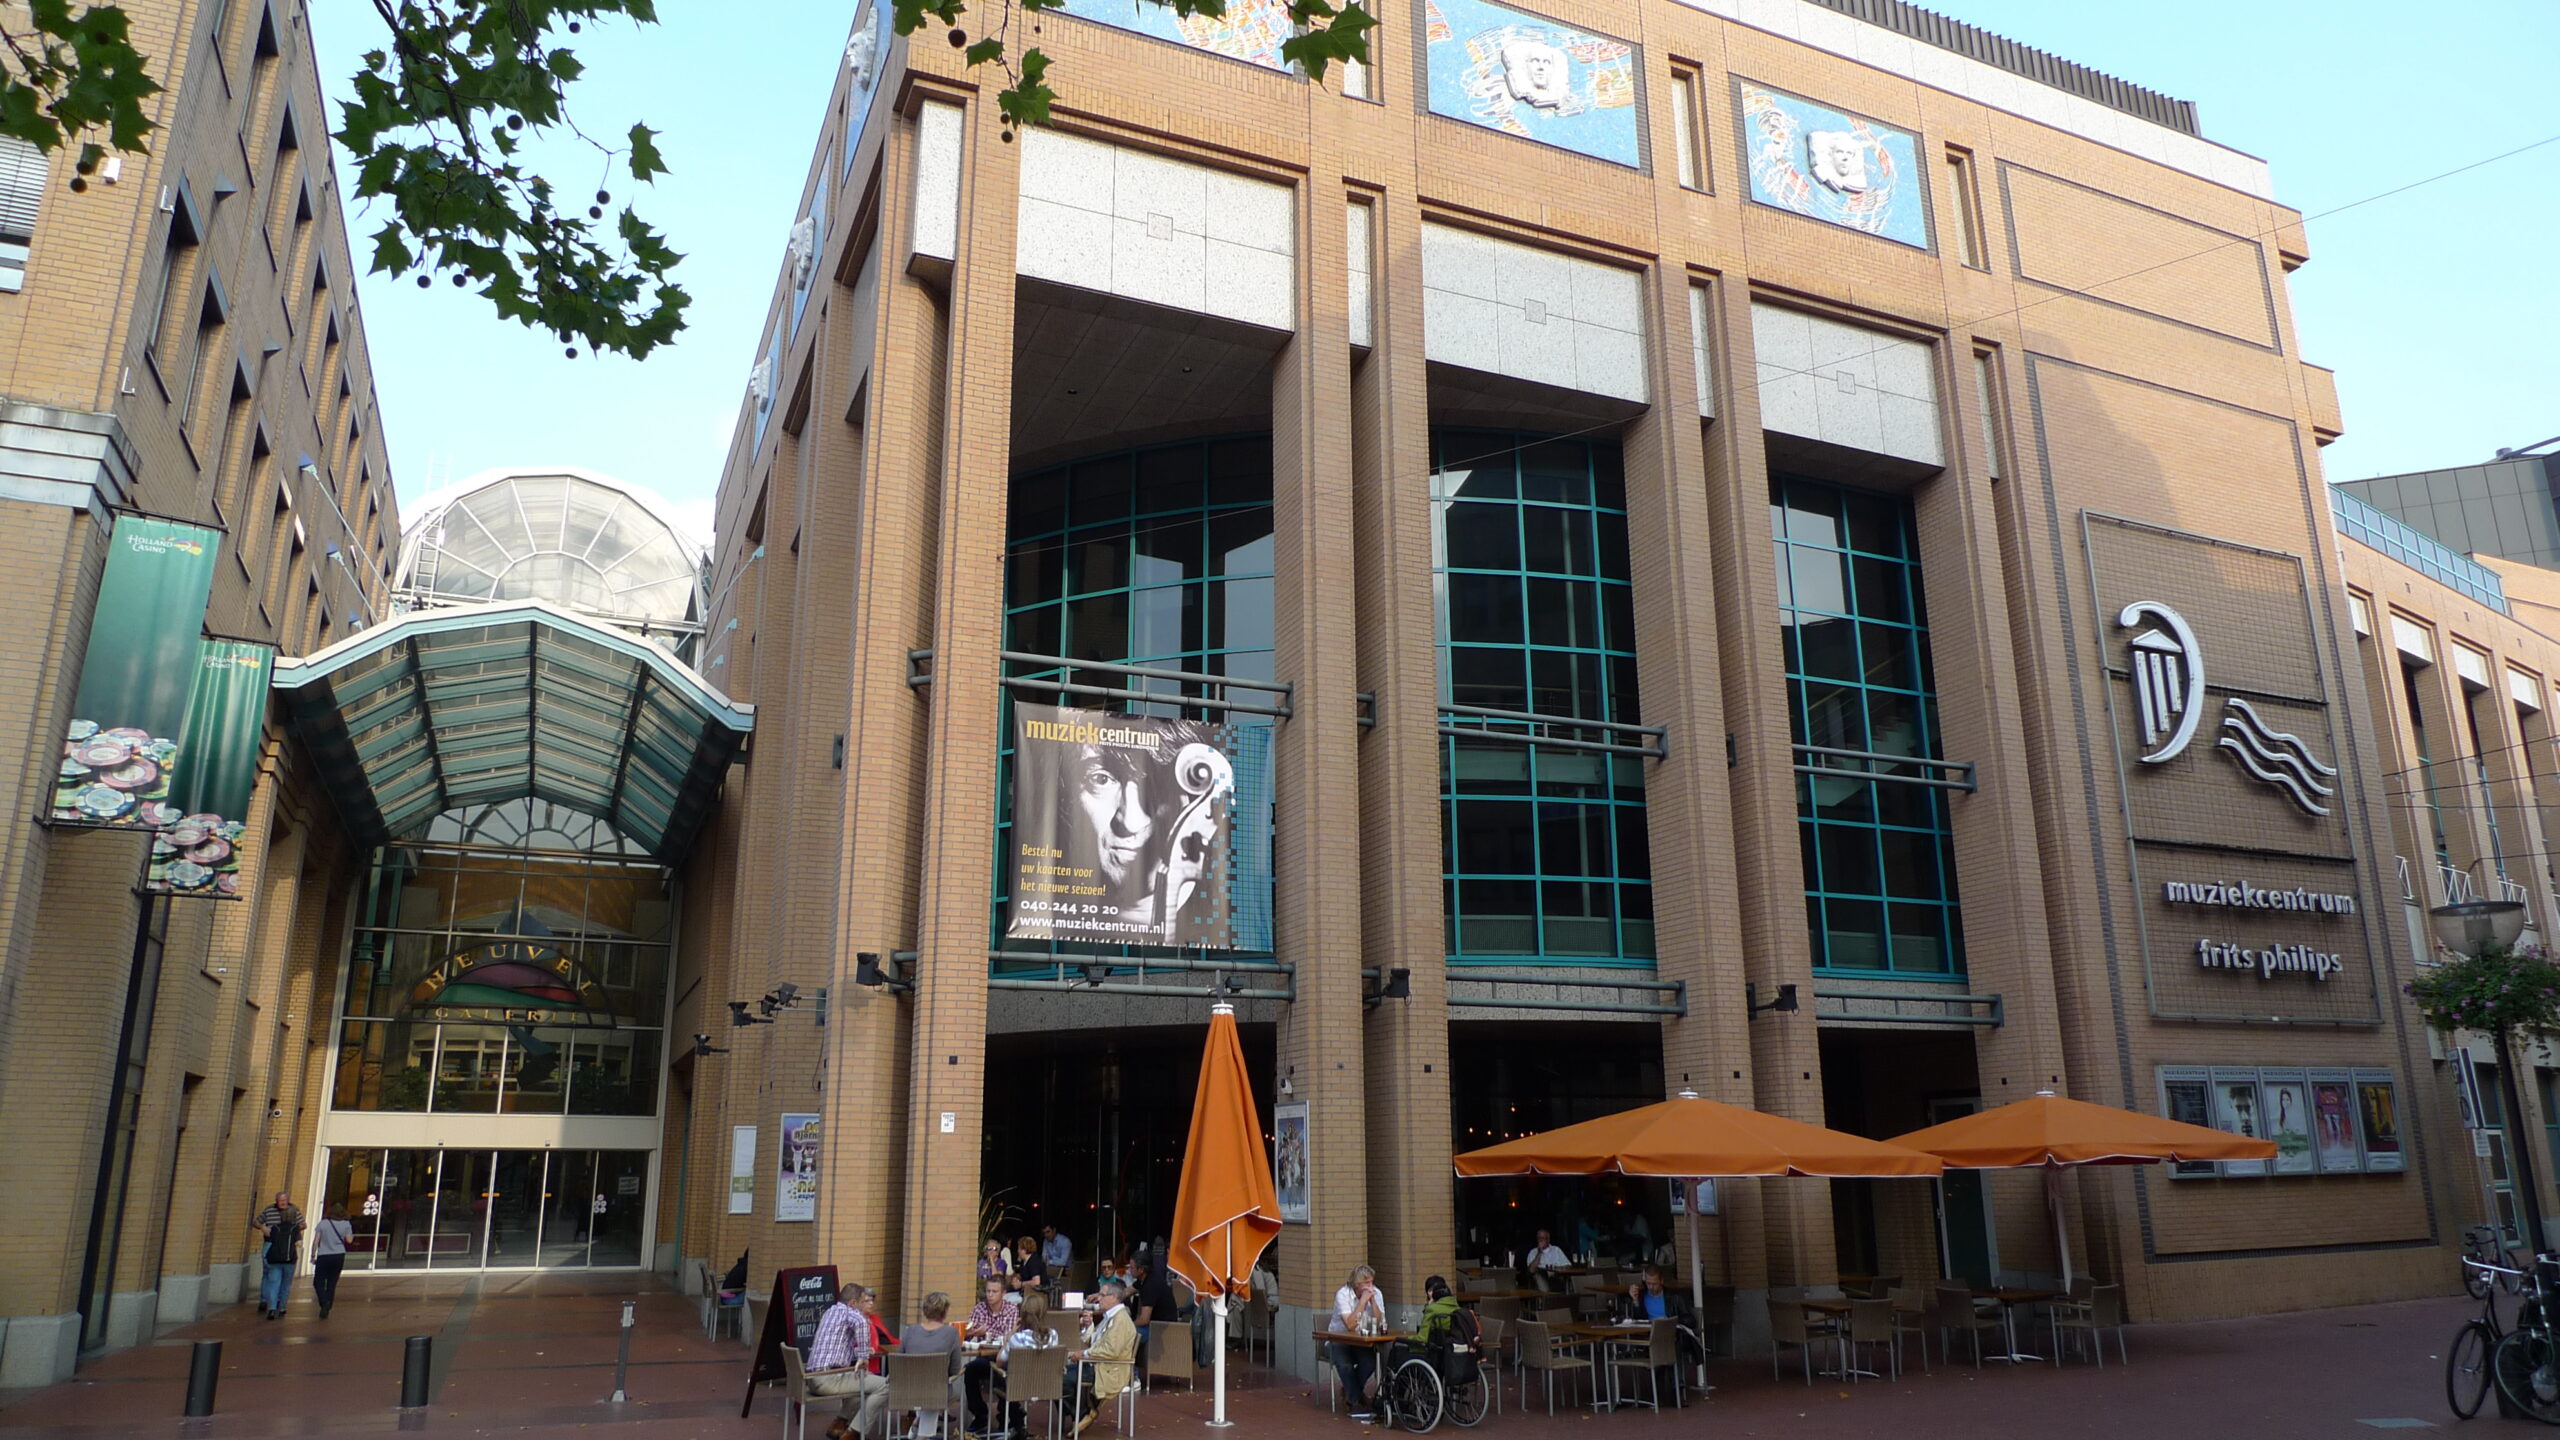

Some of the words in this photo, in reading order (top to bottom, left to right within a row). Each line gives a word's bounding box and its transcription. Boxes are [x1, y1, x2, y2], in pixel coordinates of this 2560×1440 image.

[127, 534, 173, 548] HOLLAND
[132, 542, 166, 554] CASINO
[1026, 720, 1160, 747] muziekcentrum
[1021, 843, 1049, 857] Bestel
[1051, 848, 1063, 858] nu
[1021, 864, 1034, 873] uw
[1036, 861, 1072, 876] kaarten
[1073, 868, 1094, 878] voor
[1020, 877, 1036, 891] het
[1038, 879, 1070, 894] nieuwe
[1071, 882, 1107, 897] seizoen!
[2165, 880, 2356, 915] muziekcentrum
[1020, 899, 1078, 915] 040.244
[1081, 903, 1099, 914] 20
[1102, 905, 1119, 915] 20
[1019, 916, 1165, 935] www.muziekcentrum.nl
[2197, 938, 2255, 969] frits
[2258, 942, 2344, 981] philips
